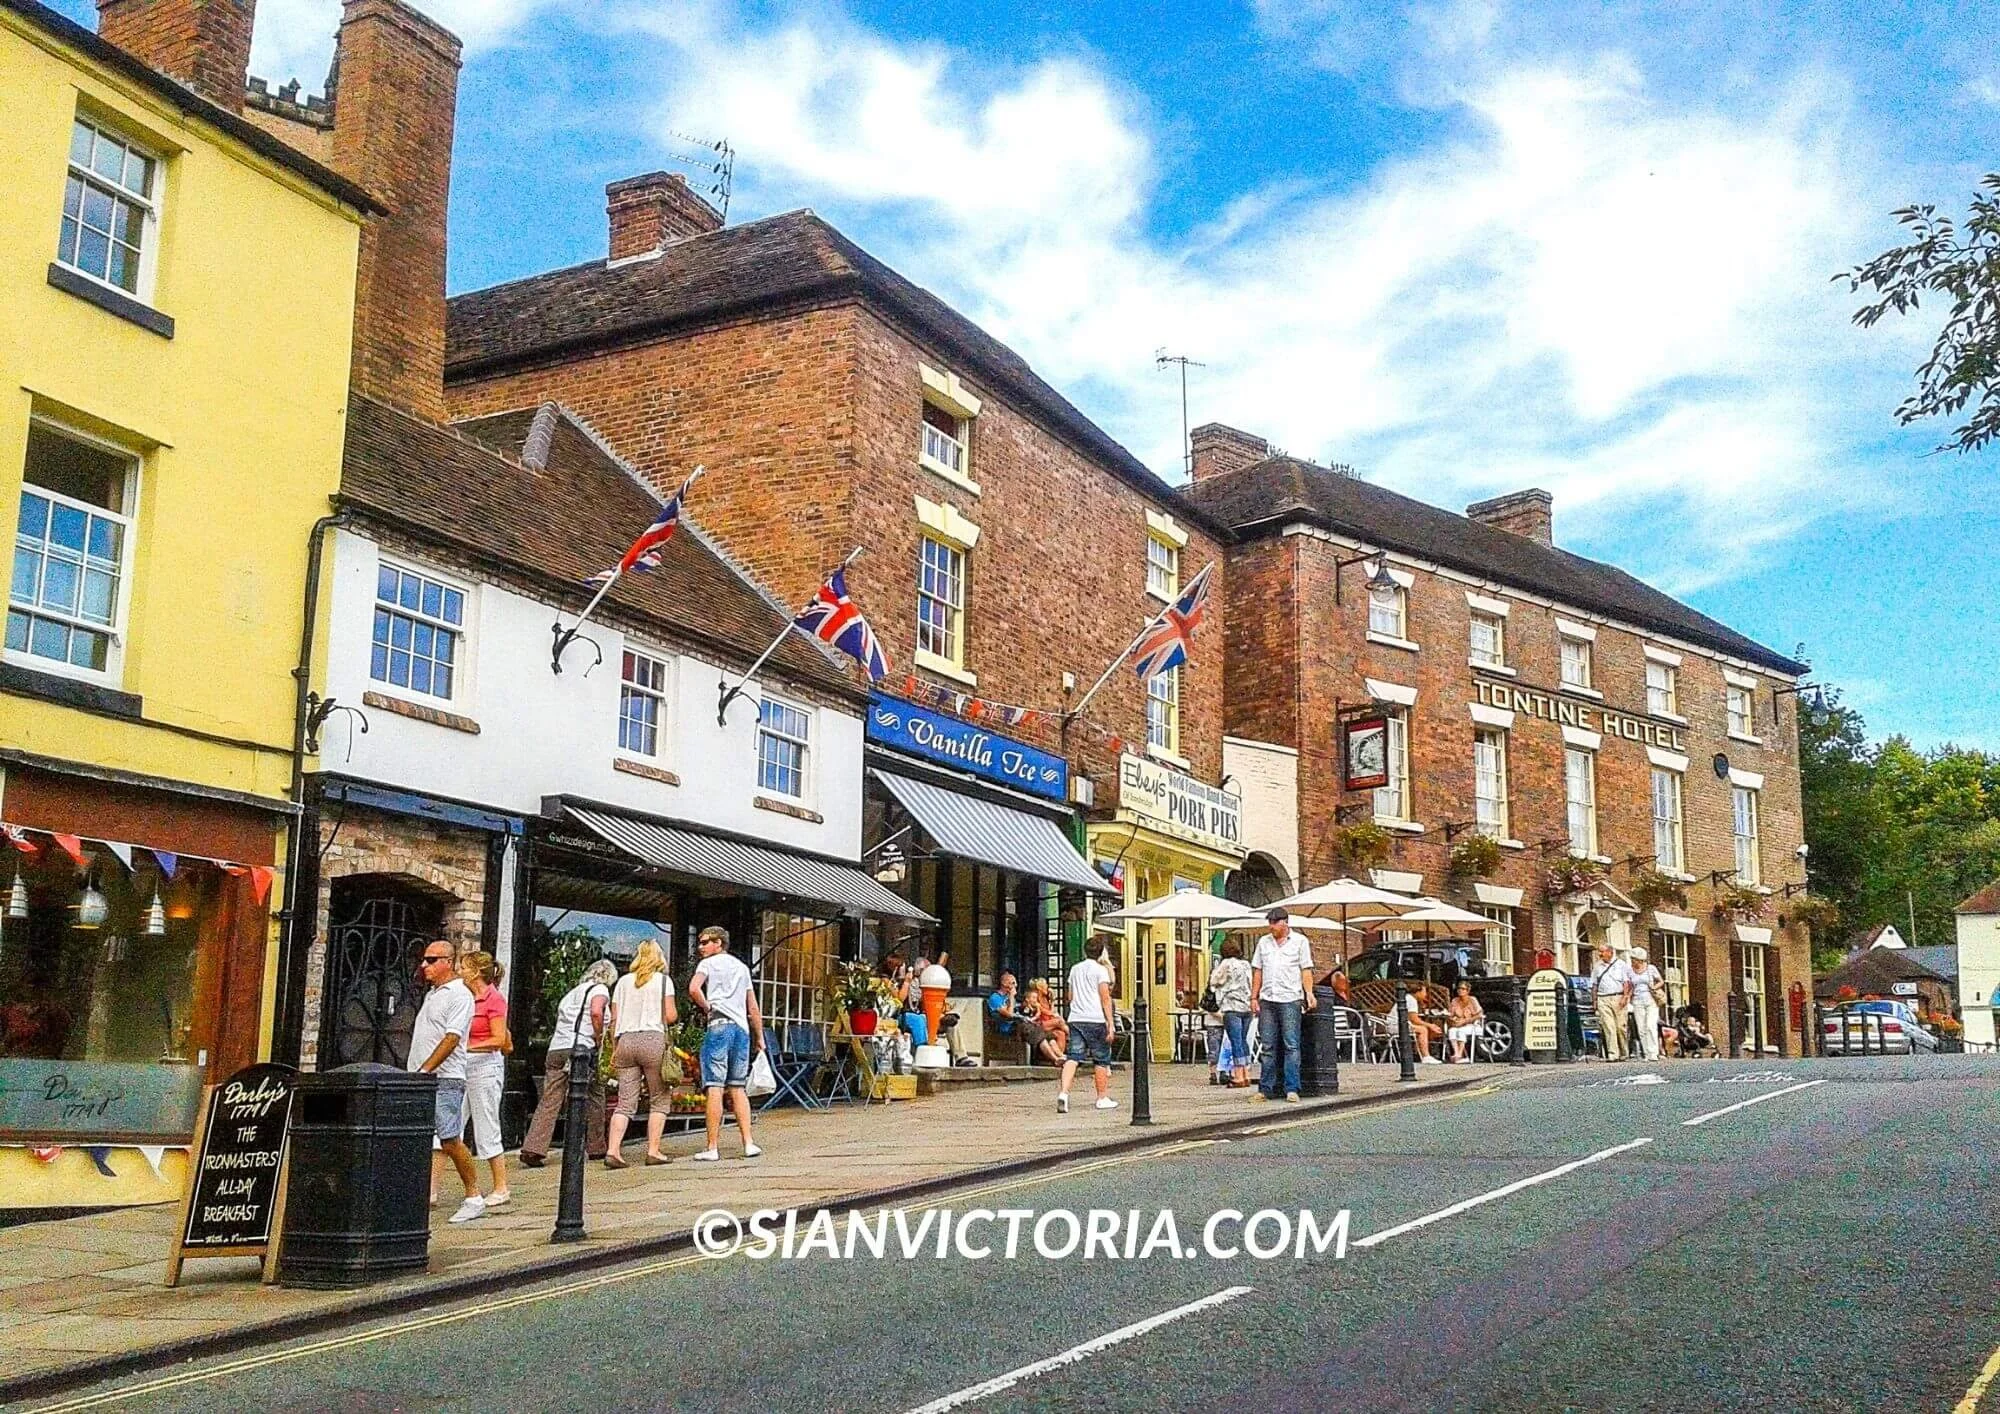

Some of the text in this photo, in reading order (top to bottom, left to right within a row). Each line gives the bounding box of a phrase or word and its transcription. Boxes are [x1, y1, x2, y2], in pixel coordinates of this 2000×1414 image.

[1473, 679, 1686, 751] TONTINE HOTEL
[907, 717, 1036, 781] Vanilla Ice
[1167, 791, 1238, 842] PORK PIES
[224, 1076, 287, 1117] Darby's
[236, 1125, 258, 1145] THE
[215, 1177, 257, 1202] ALL-DAY
[203, 1204, 261, 1223] BREAKFAST
